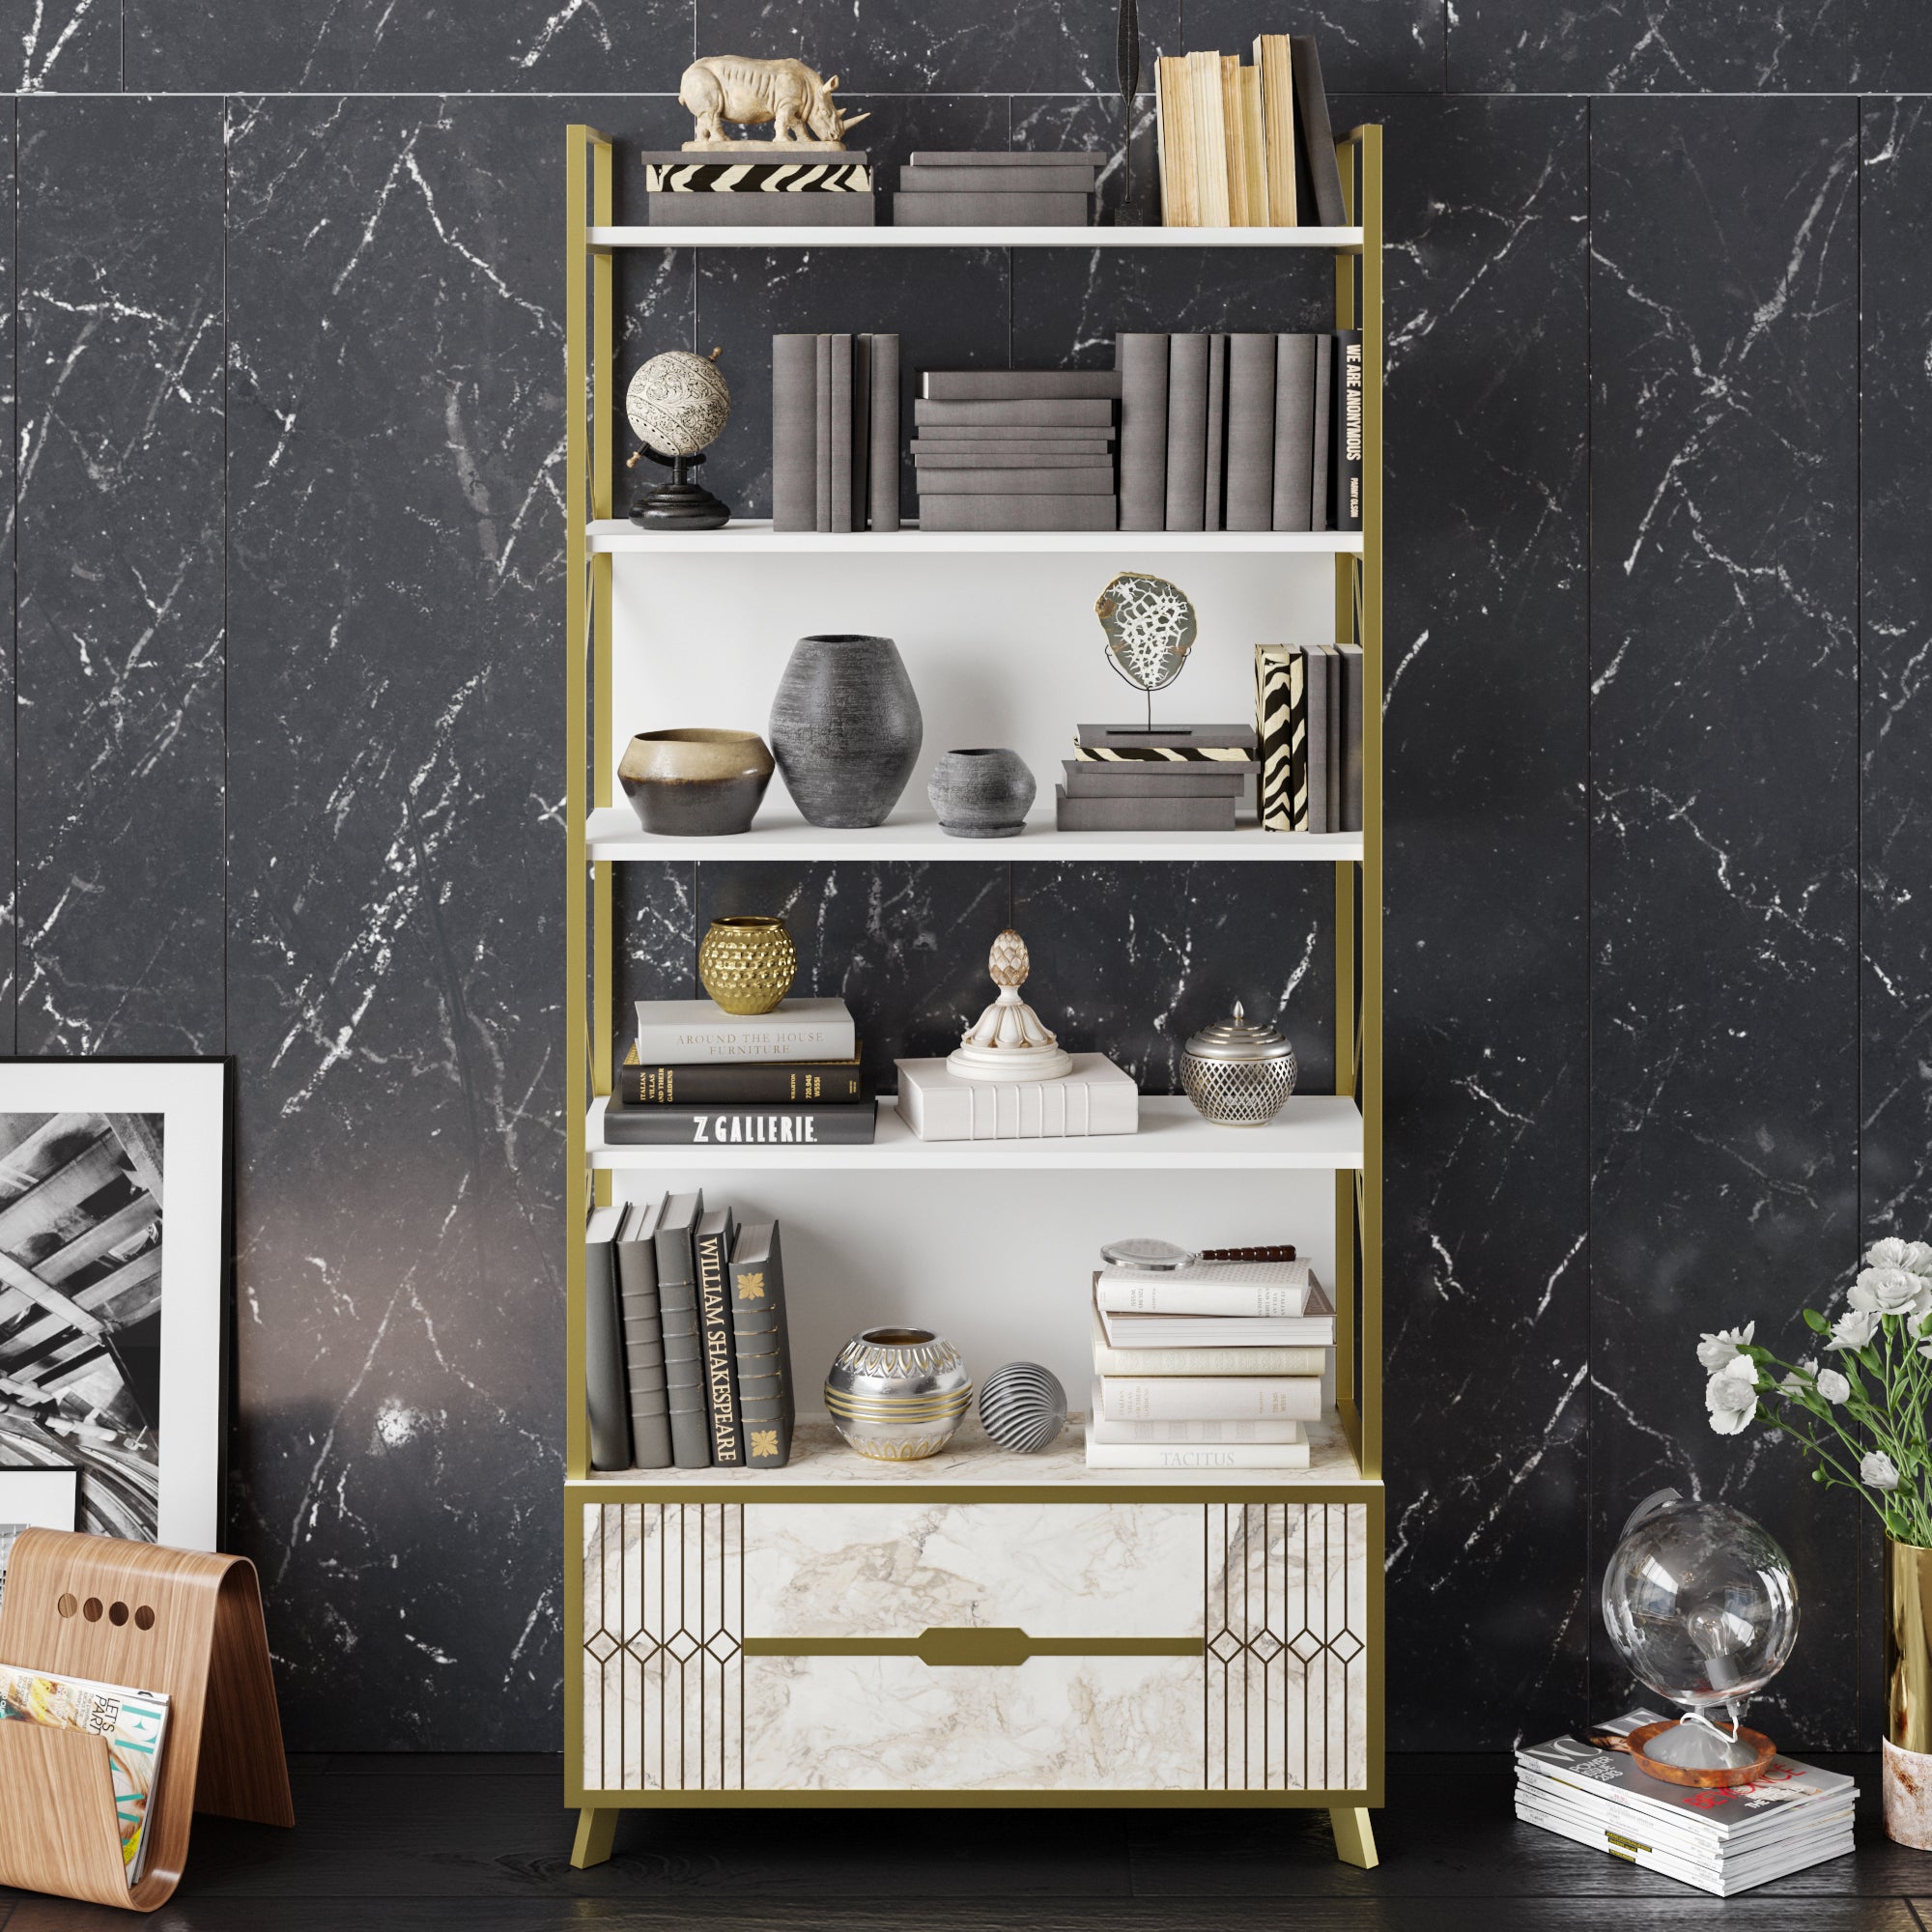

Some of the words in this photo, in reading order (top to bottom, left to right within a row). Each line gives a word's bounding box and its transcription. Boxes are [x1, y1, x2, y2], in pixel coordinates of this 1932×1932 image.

[1346, 344, 1361, 363] WE
[1346, 363, 1361, 387] ARE
[1346, 388, 1361, 461] ANONYMOUS
[1350, 477, 1359, 498] PARMY
[1350, 498, 1359, 518] OLSON
[678, 1034, 736, 1044] AROUND
[743, 1033, 772, 1043] THE
[777, 1032, 824, 1042] HOUSE
[710, 1044, 790, 1055] FURNITURE
[694, 1116, 709, 1143] Z
[698, 1237, 724, 1326] WILLIAM
[707, 1331, 737, 1462] SHAKESPEARE
[1160, 1452, 1236, 1466] TACITUS
[101, 1697, 121, 1733] LET'S
[1569, 1755, 1614, 1773] POWER
[1595, 1770, 1624, 1782] 2013
[1744, 1799, 1771, 1809] THE
